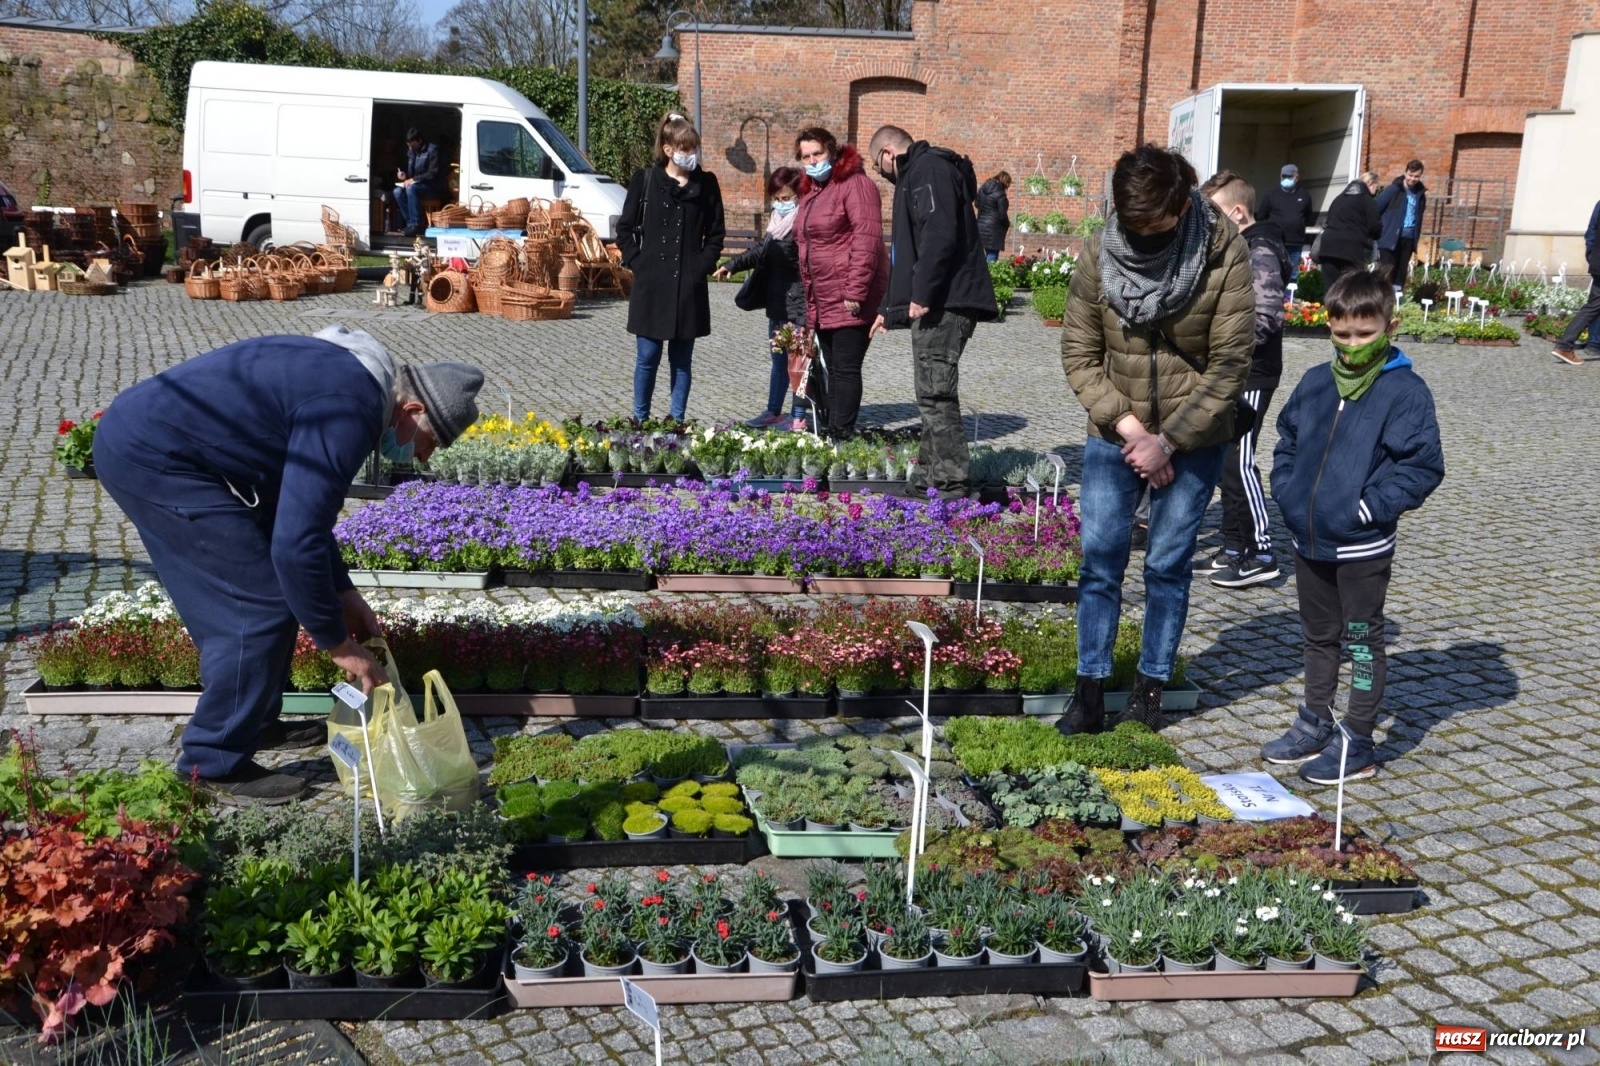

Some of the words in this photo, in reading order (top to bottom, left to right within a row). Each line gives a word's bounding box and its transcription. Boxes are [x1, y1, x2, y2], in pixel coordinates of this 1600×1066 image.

[1348, 621, 1369, 640] BE
[1348, 644, 1374, 691] GREEN
[1222, 782, 1257, 808] Stoisko
